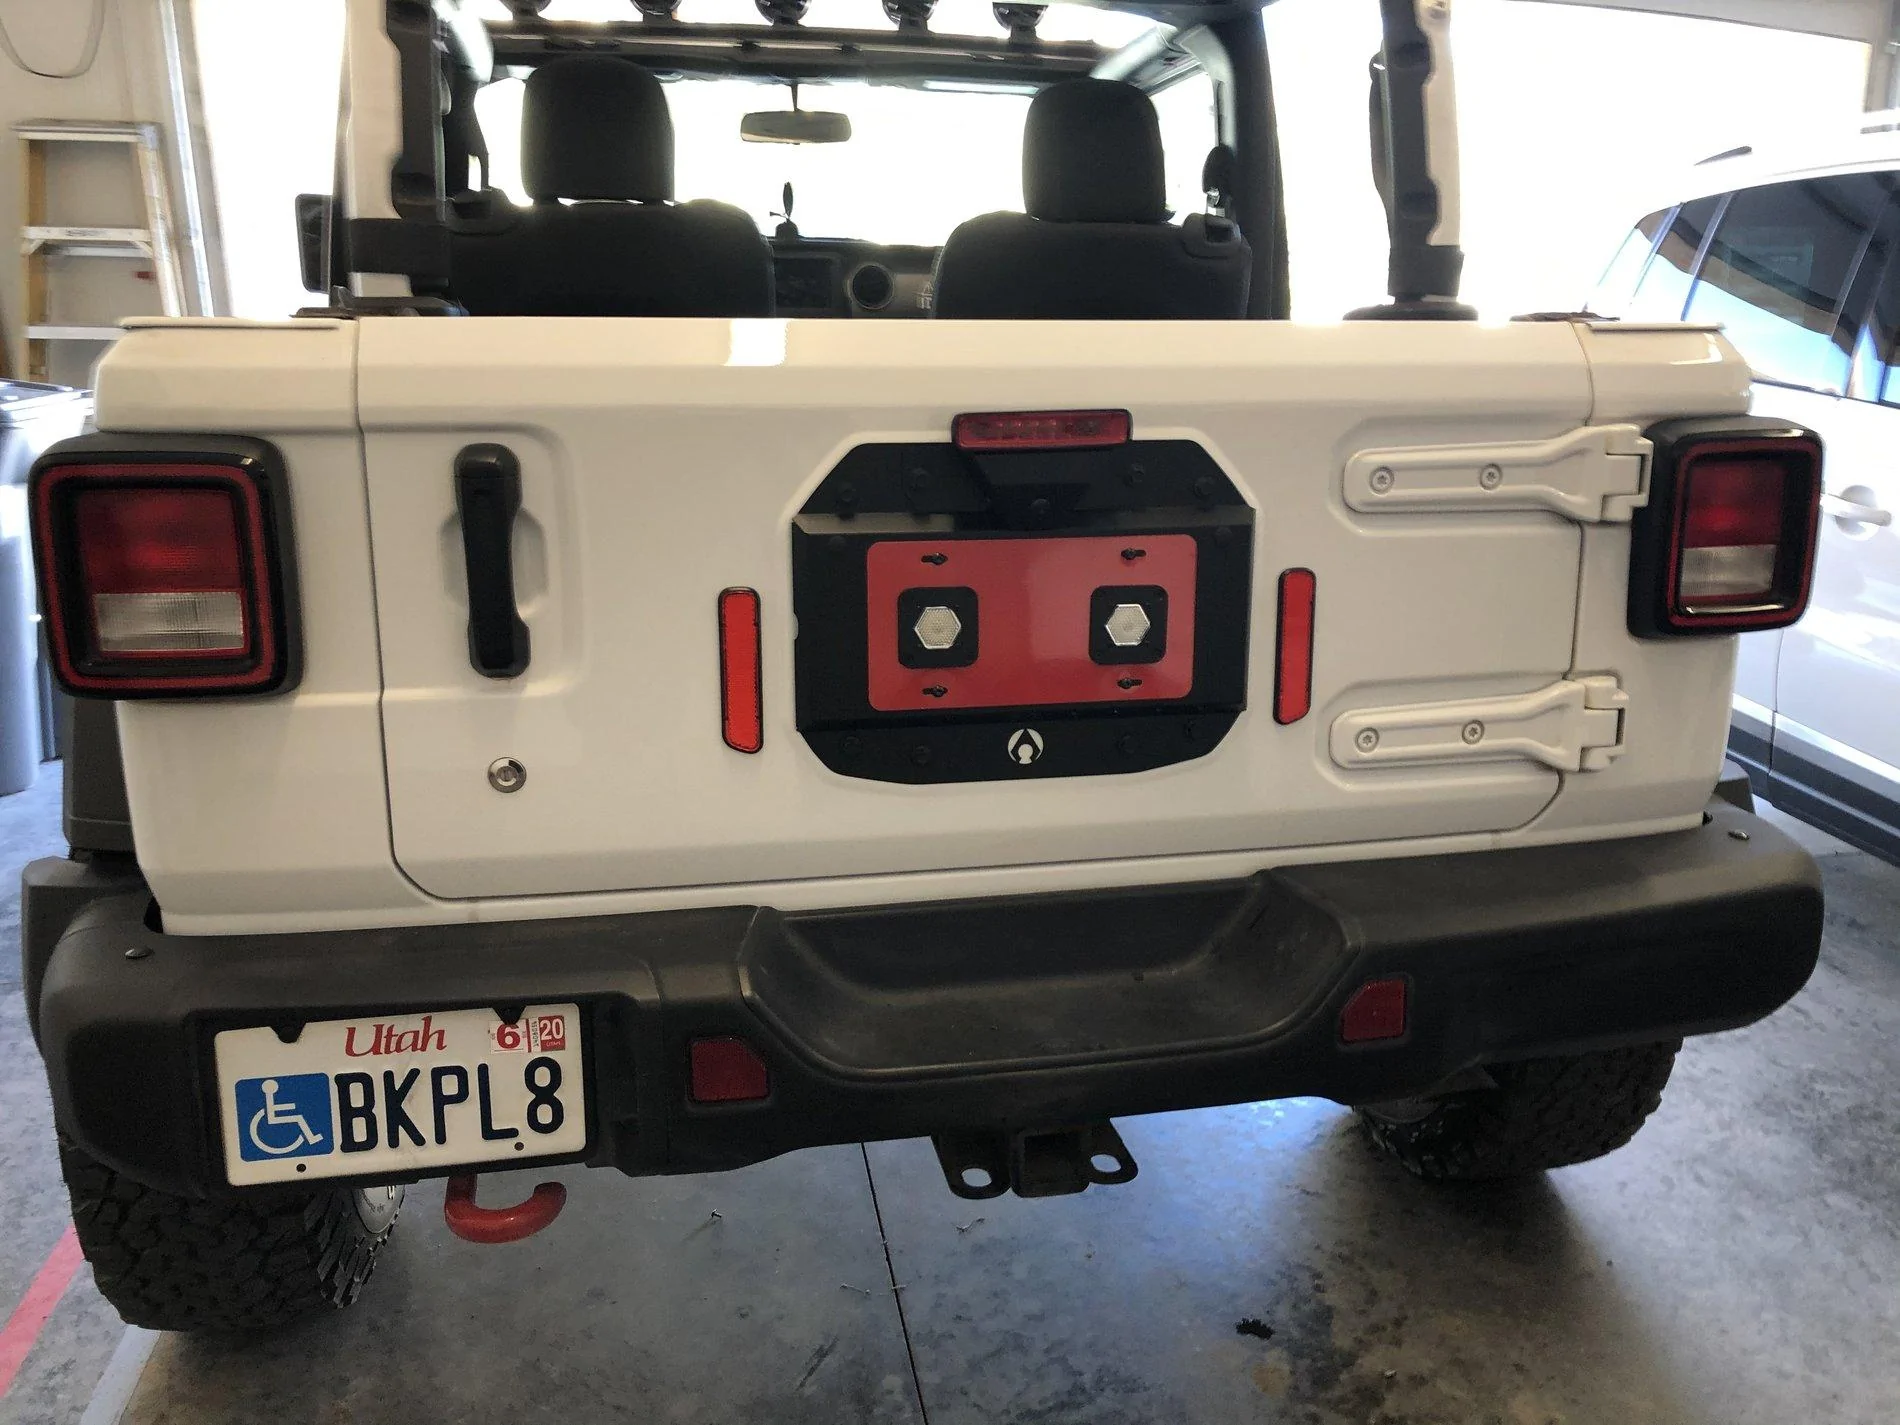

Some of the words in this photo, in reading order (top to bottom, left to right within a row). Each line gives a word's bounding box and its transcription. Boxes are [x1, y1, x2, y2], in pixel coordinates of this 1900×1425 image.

[345, 1016, 447, 1057] Utah
[496, 1023, 521, 1049] 6
[540, 1018, 564, 1041] 20
[334, 1056, 564, 1154] BKPL8
